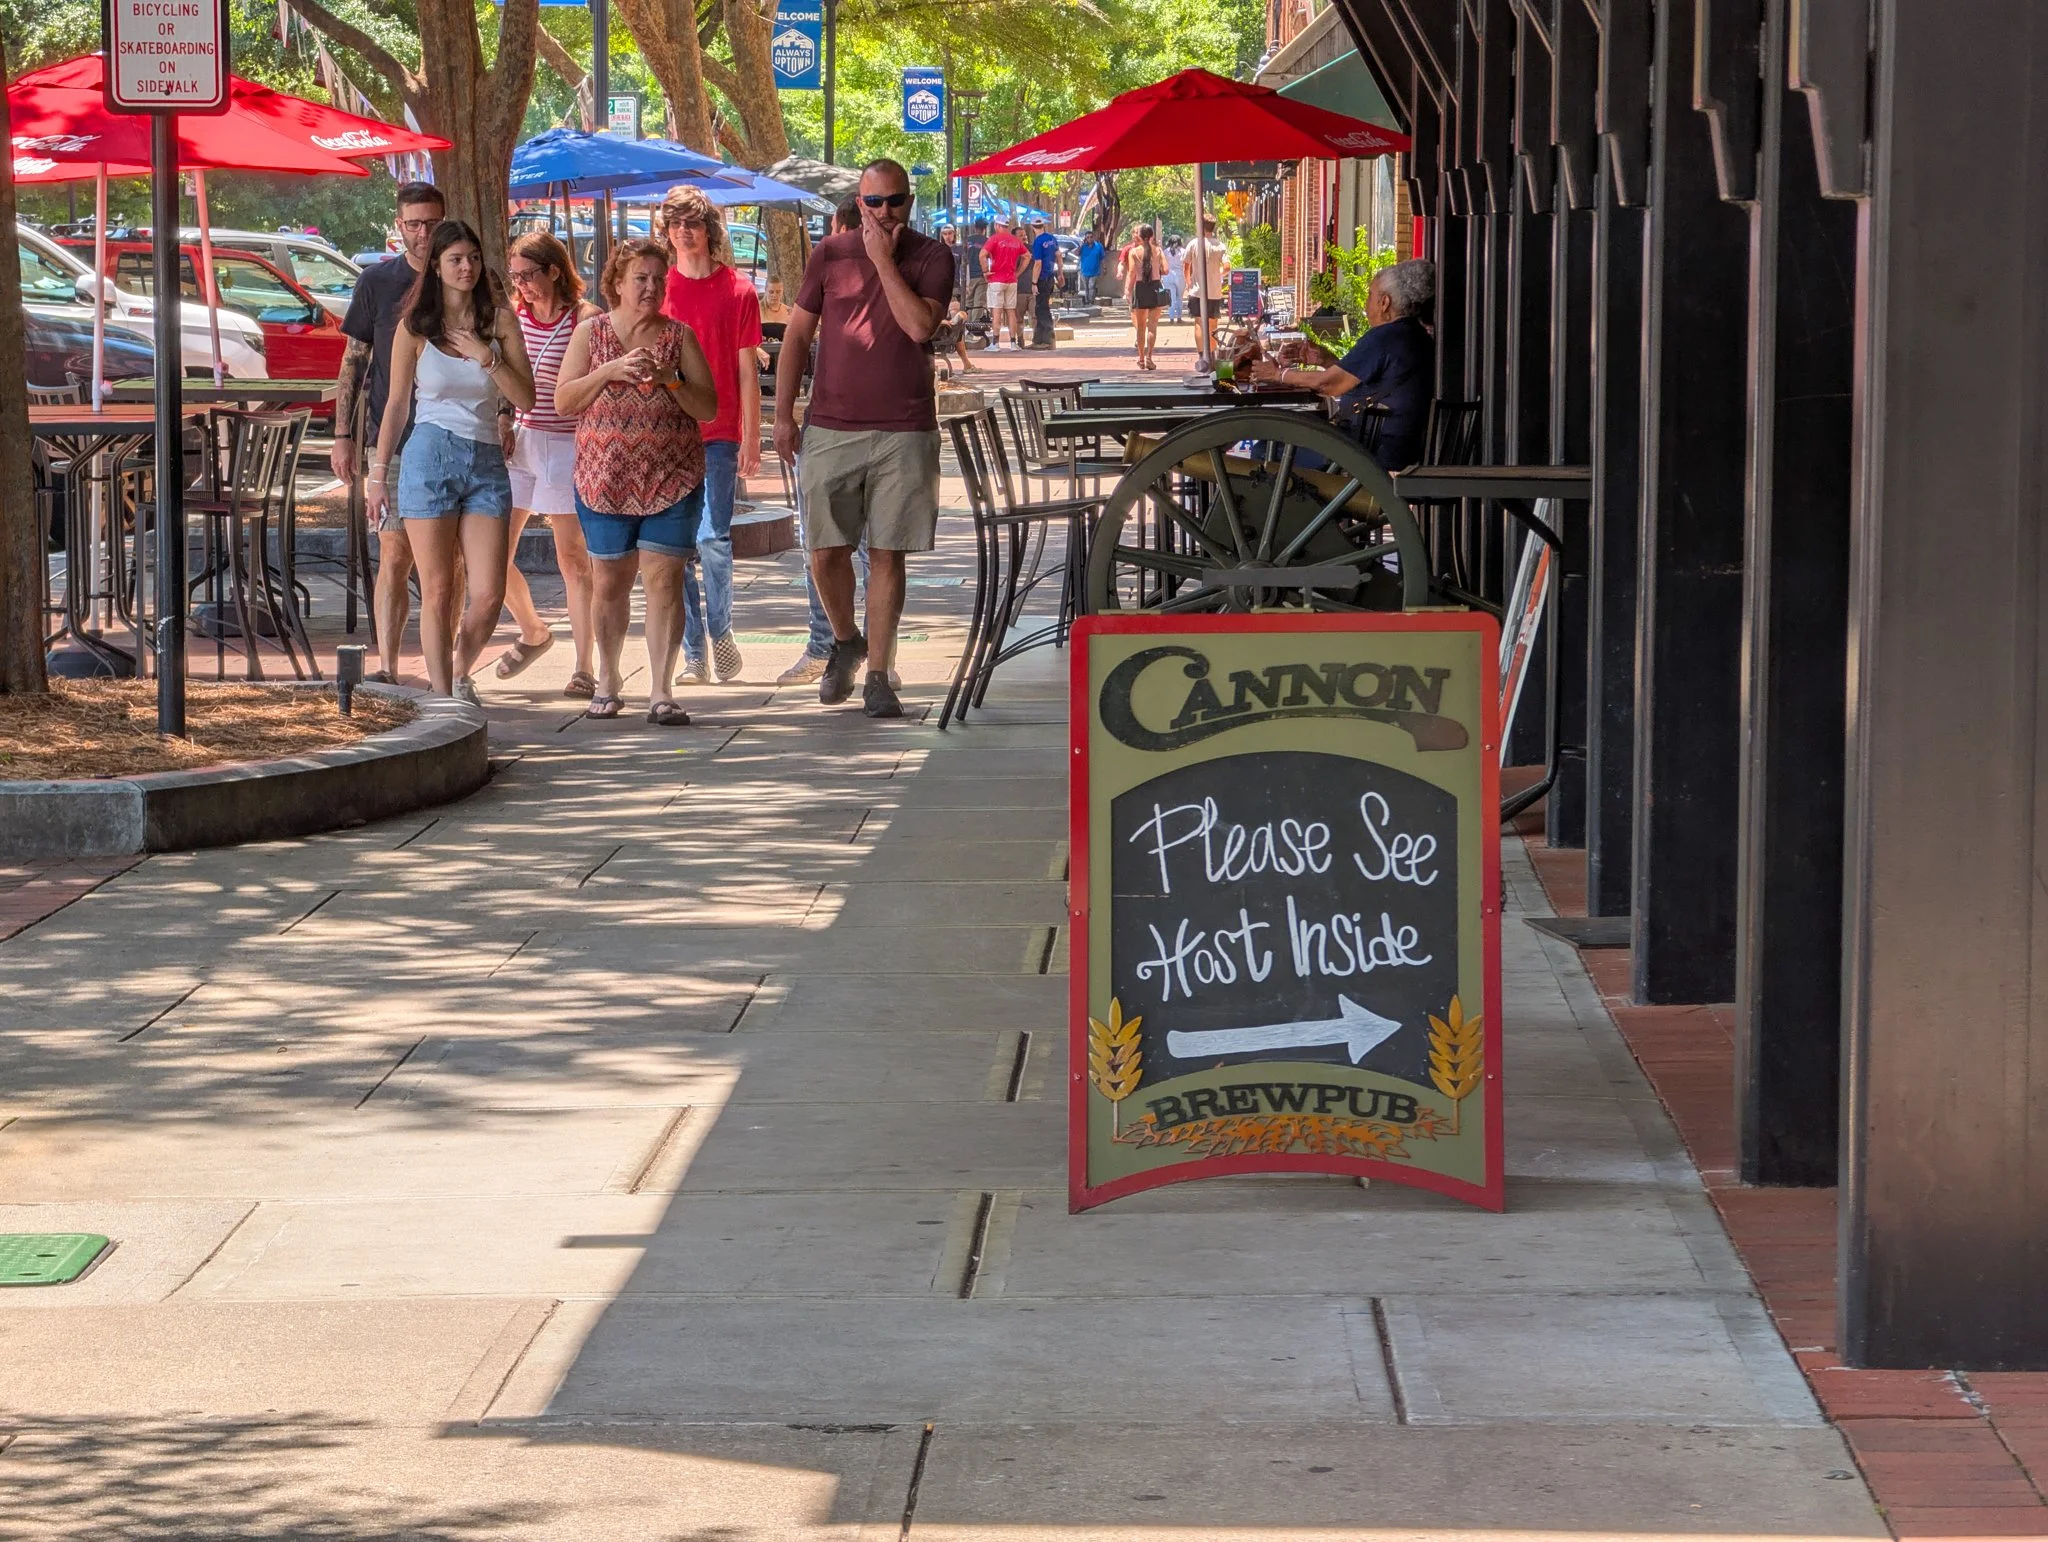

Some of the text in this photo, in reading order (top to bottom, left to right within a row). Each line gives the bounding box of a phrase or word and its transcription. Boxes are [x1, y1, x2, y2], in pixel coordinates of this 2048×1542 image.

[133, 3, 199, 17] BICYCLING
[776, 12, 820, 21] ELCOME
[158, 23, 175, 36] OR
[120, 42, 214, 55] SKATEBOARDING
[775, 49, 811, 57] ALWAYS
[159, 61, 176, 74] ON
[774, 57, 811, 73] UPTOWN
[137, 80, 198, 93] SIDEWALK
[910, 110, 937, 121] UPTOWN
[1099, 645, 1469, 752] CANNON
[1129, 791, 1439, 894] Please See
[1136, 895, 1433, 1002] Host Inside
[1145, 1083, 1419, 1132] BREWPUB
